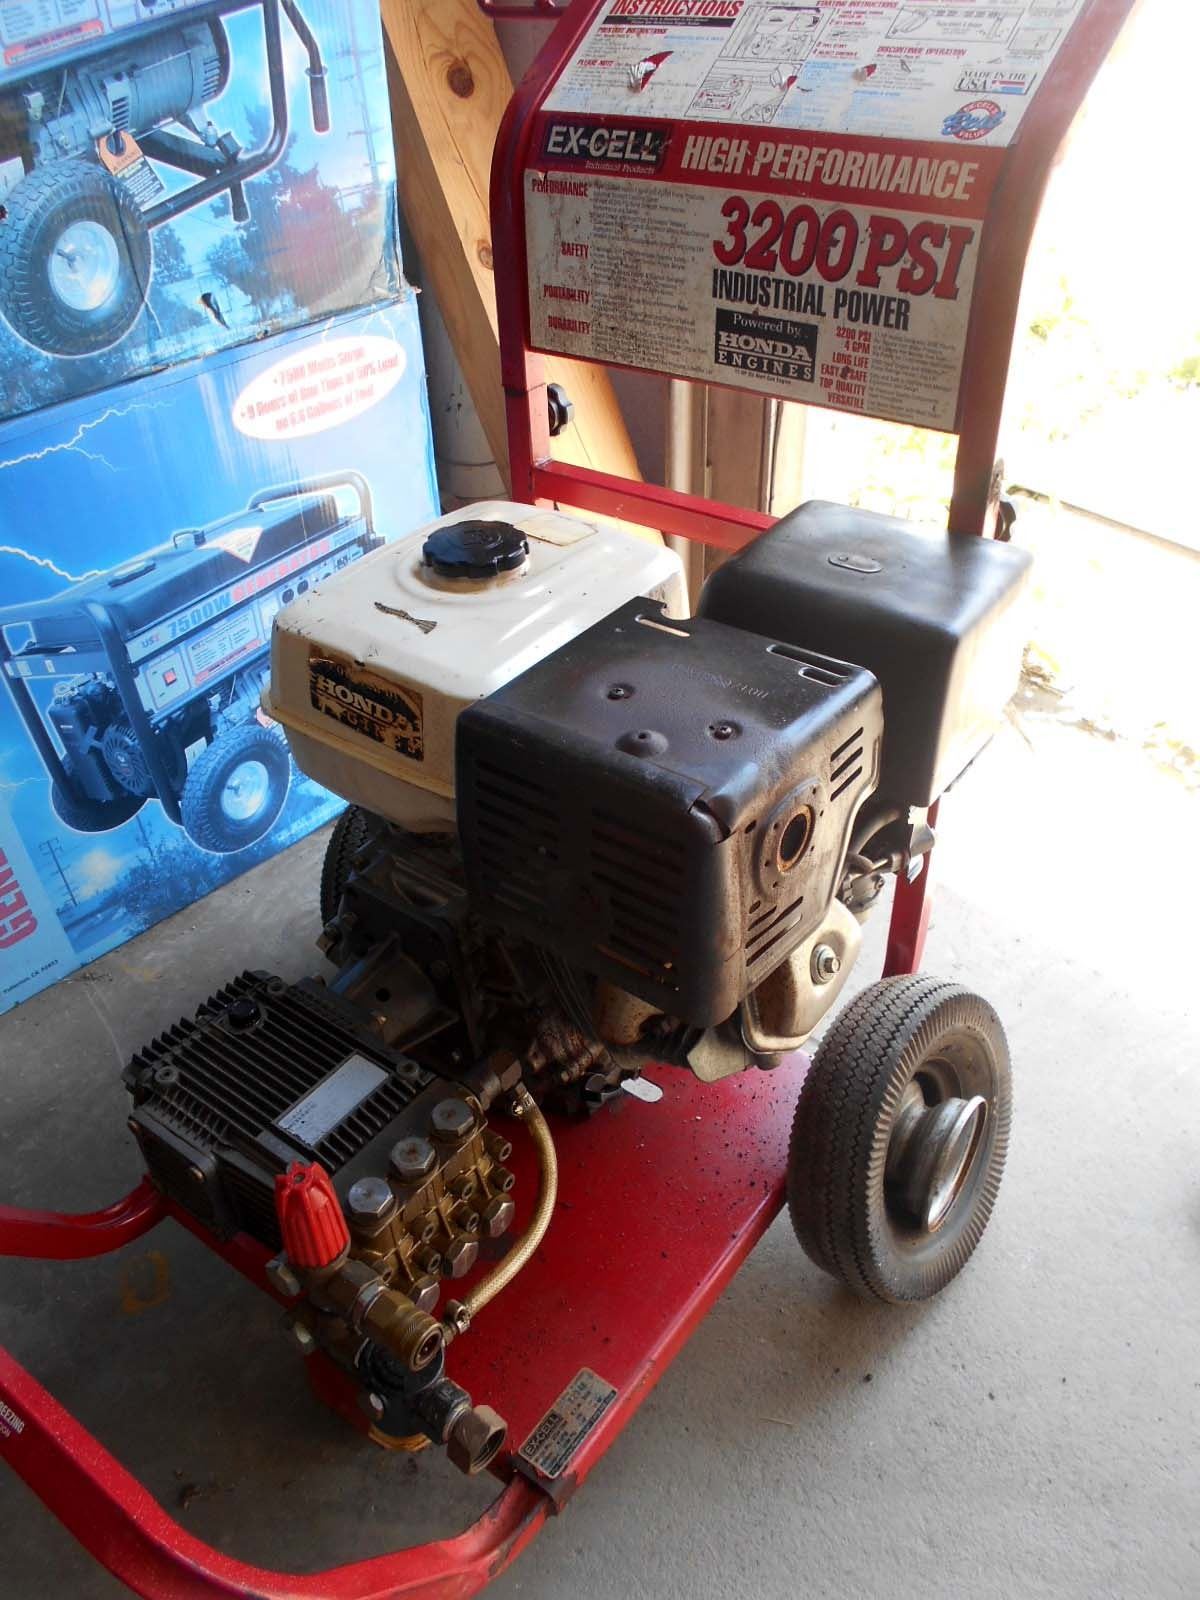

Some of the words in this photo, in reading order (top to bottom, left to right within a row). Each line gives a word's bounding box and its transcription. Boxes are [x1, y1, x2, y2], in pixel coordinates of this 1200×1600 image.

[609, 0, 744, 17] INSTRUCTIONS
[957, 78, 989, 91] USA
[962, 70, 990, 80] MADE
[993, 72, 1005, 80] IN
[1007, 73, 1028, 81] THE
[546, 125, 657, 161] EX-CELL
[680, 135, 748, 175] HIGH
[752, 141, 979, 201] PERFORMANCE
[531, 179, 588, 198] PERFORMANCE
[561, 241, 589, 260] SAFETY
[713, 195, 859, 283] 3200
[855, 214, 976, 301] PSI
[543, 284, 590, 305] PORTABILITY
[711, 267, 827, 318] INDUSTRIAL
[833, 287, 911, 332] POWER
[548, 315, 591, 335] DURABILITY
[733, 312, 783, 334] Powered
[836, 325, 855, 341] 3200
[858, 328, 872, 343] PSI
[718, 331, 812, 362] HONDA
[844, 340, 850, 352] 4
[852, 341, 870, 355] GPM
[718, 350, 812, 380] ENGINES
[832, 351, 852, 367] LONG
[853, 357, 869, 369] LIFE
[820, 376, 834, 389] TOP
[835, 380, 866, 397] QUALITY
[827, 391, 865, 410] VERSATILE
[166, 590, 232, 640] 7500W
[230, 538, 331, 604] GENERATOR
[317, 674, 413, 732] HONDA
[0, 847, 38, 950] GEN
